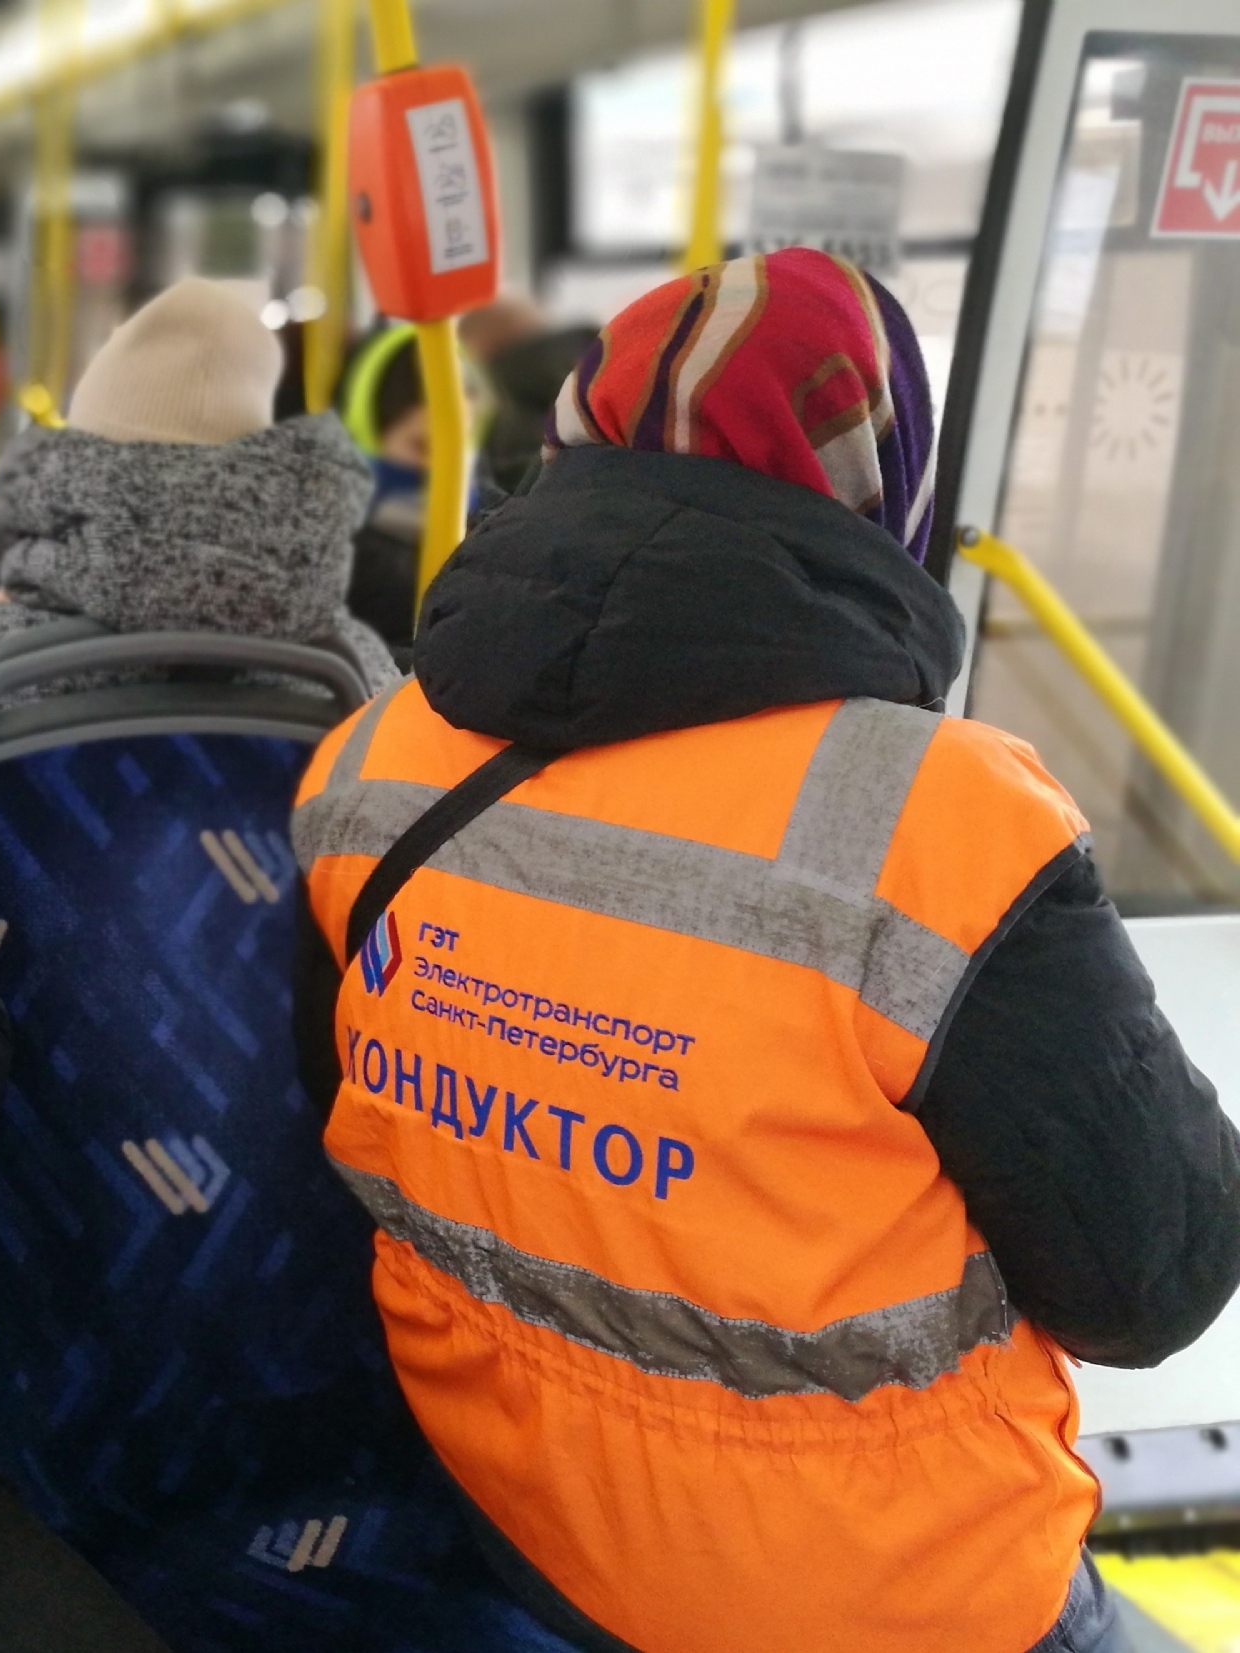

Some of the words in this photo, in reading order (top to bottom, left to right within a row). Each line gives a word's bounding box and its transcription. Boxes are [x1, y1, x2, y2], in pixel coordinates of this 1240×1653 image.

[411, 989, 679, 1092] Санкт-Петербурга
[413, 956, 696, 1056] Электротранспорт
[345, 1024, 695, 1200] КОНДУКТОР
